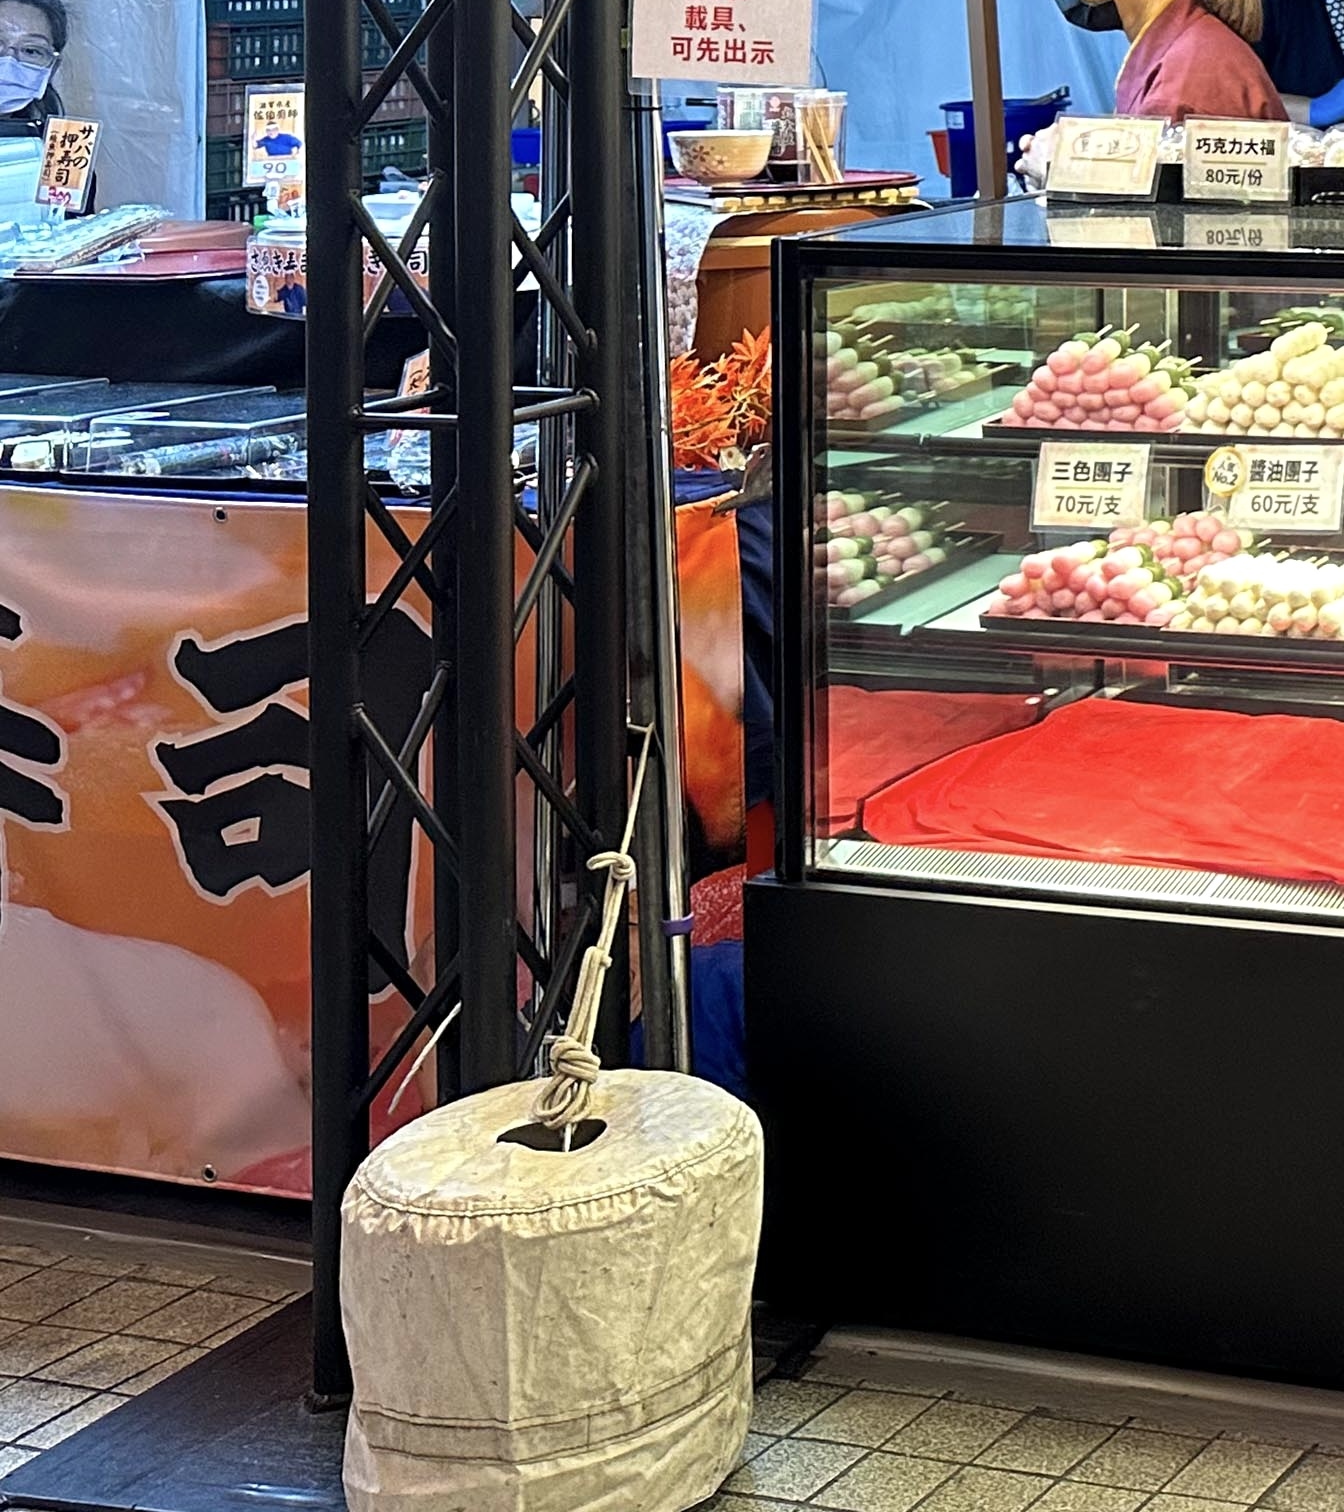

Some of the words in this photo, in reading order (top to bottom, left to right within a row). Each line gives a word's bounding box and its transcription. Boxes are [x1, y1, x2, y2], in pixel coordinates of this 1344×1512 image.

[684, 5, 749, 32] 載具、
[671, 36, 776, 65] 可先出示
[1195, 137, 1276, 156] 巧克力大福
[262, 162, 287, 174] 90
[1205, 168, 1263, 187] 80元/份
[1051, 460, 1133, 483] 三色團子
[1212, 471, 1239, 486] No.2
[1249, 459, 1320, 484] 醬油團子
[1055, 494, 1121, 516] 70元/支
[1250, 494, 1320, 516] 60元/支
